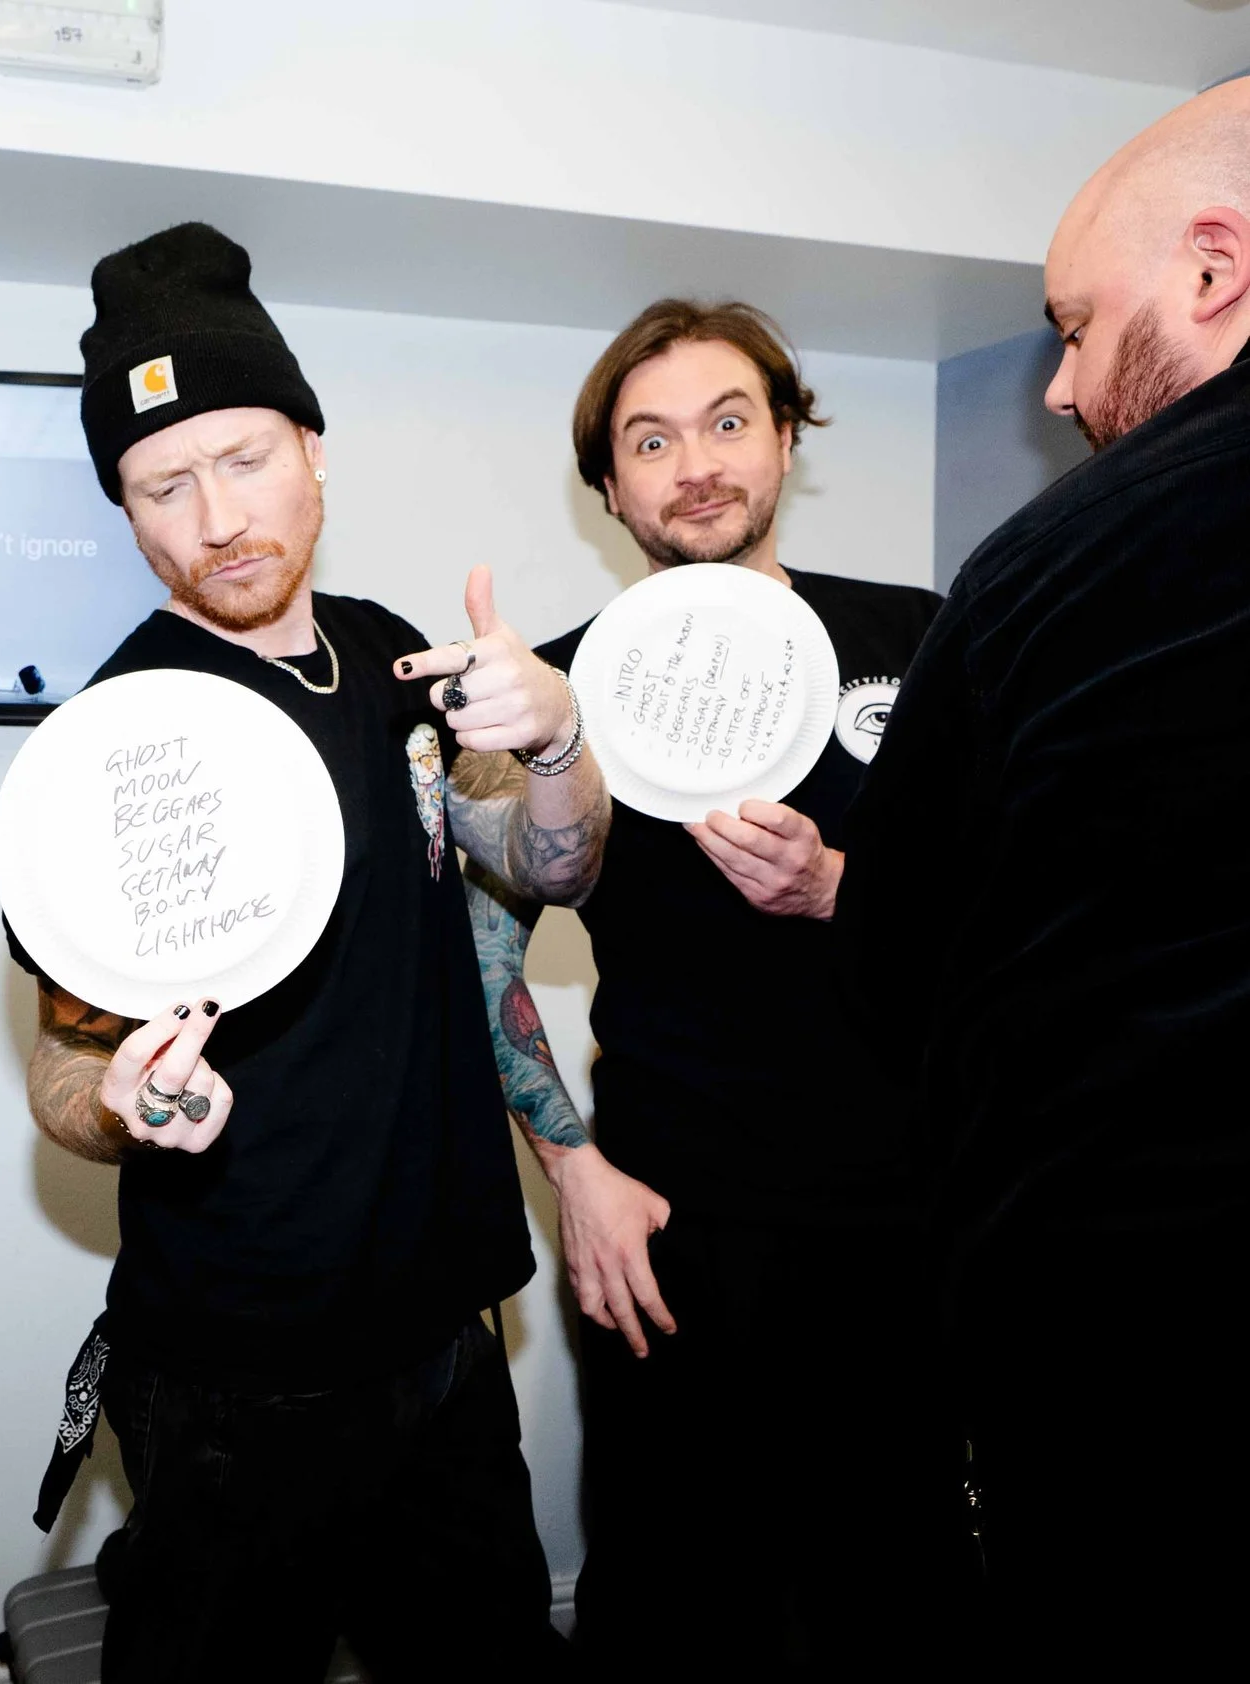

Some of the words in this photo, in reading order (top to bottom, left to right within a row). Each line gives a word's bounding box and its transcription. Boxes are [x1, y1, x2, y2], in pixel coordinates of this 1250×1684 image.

[20, 534, 98, 561] ignore
[686, 696, 712, 745] SUGAR
[106, 736, 188, 776] GHOST
[114, 761, 202, 804] MOON
[114, 788, 223, 838] BEGGARS
[118, 822, 218, 869] SUGAR
